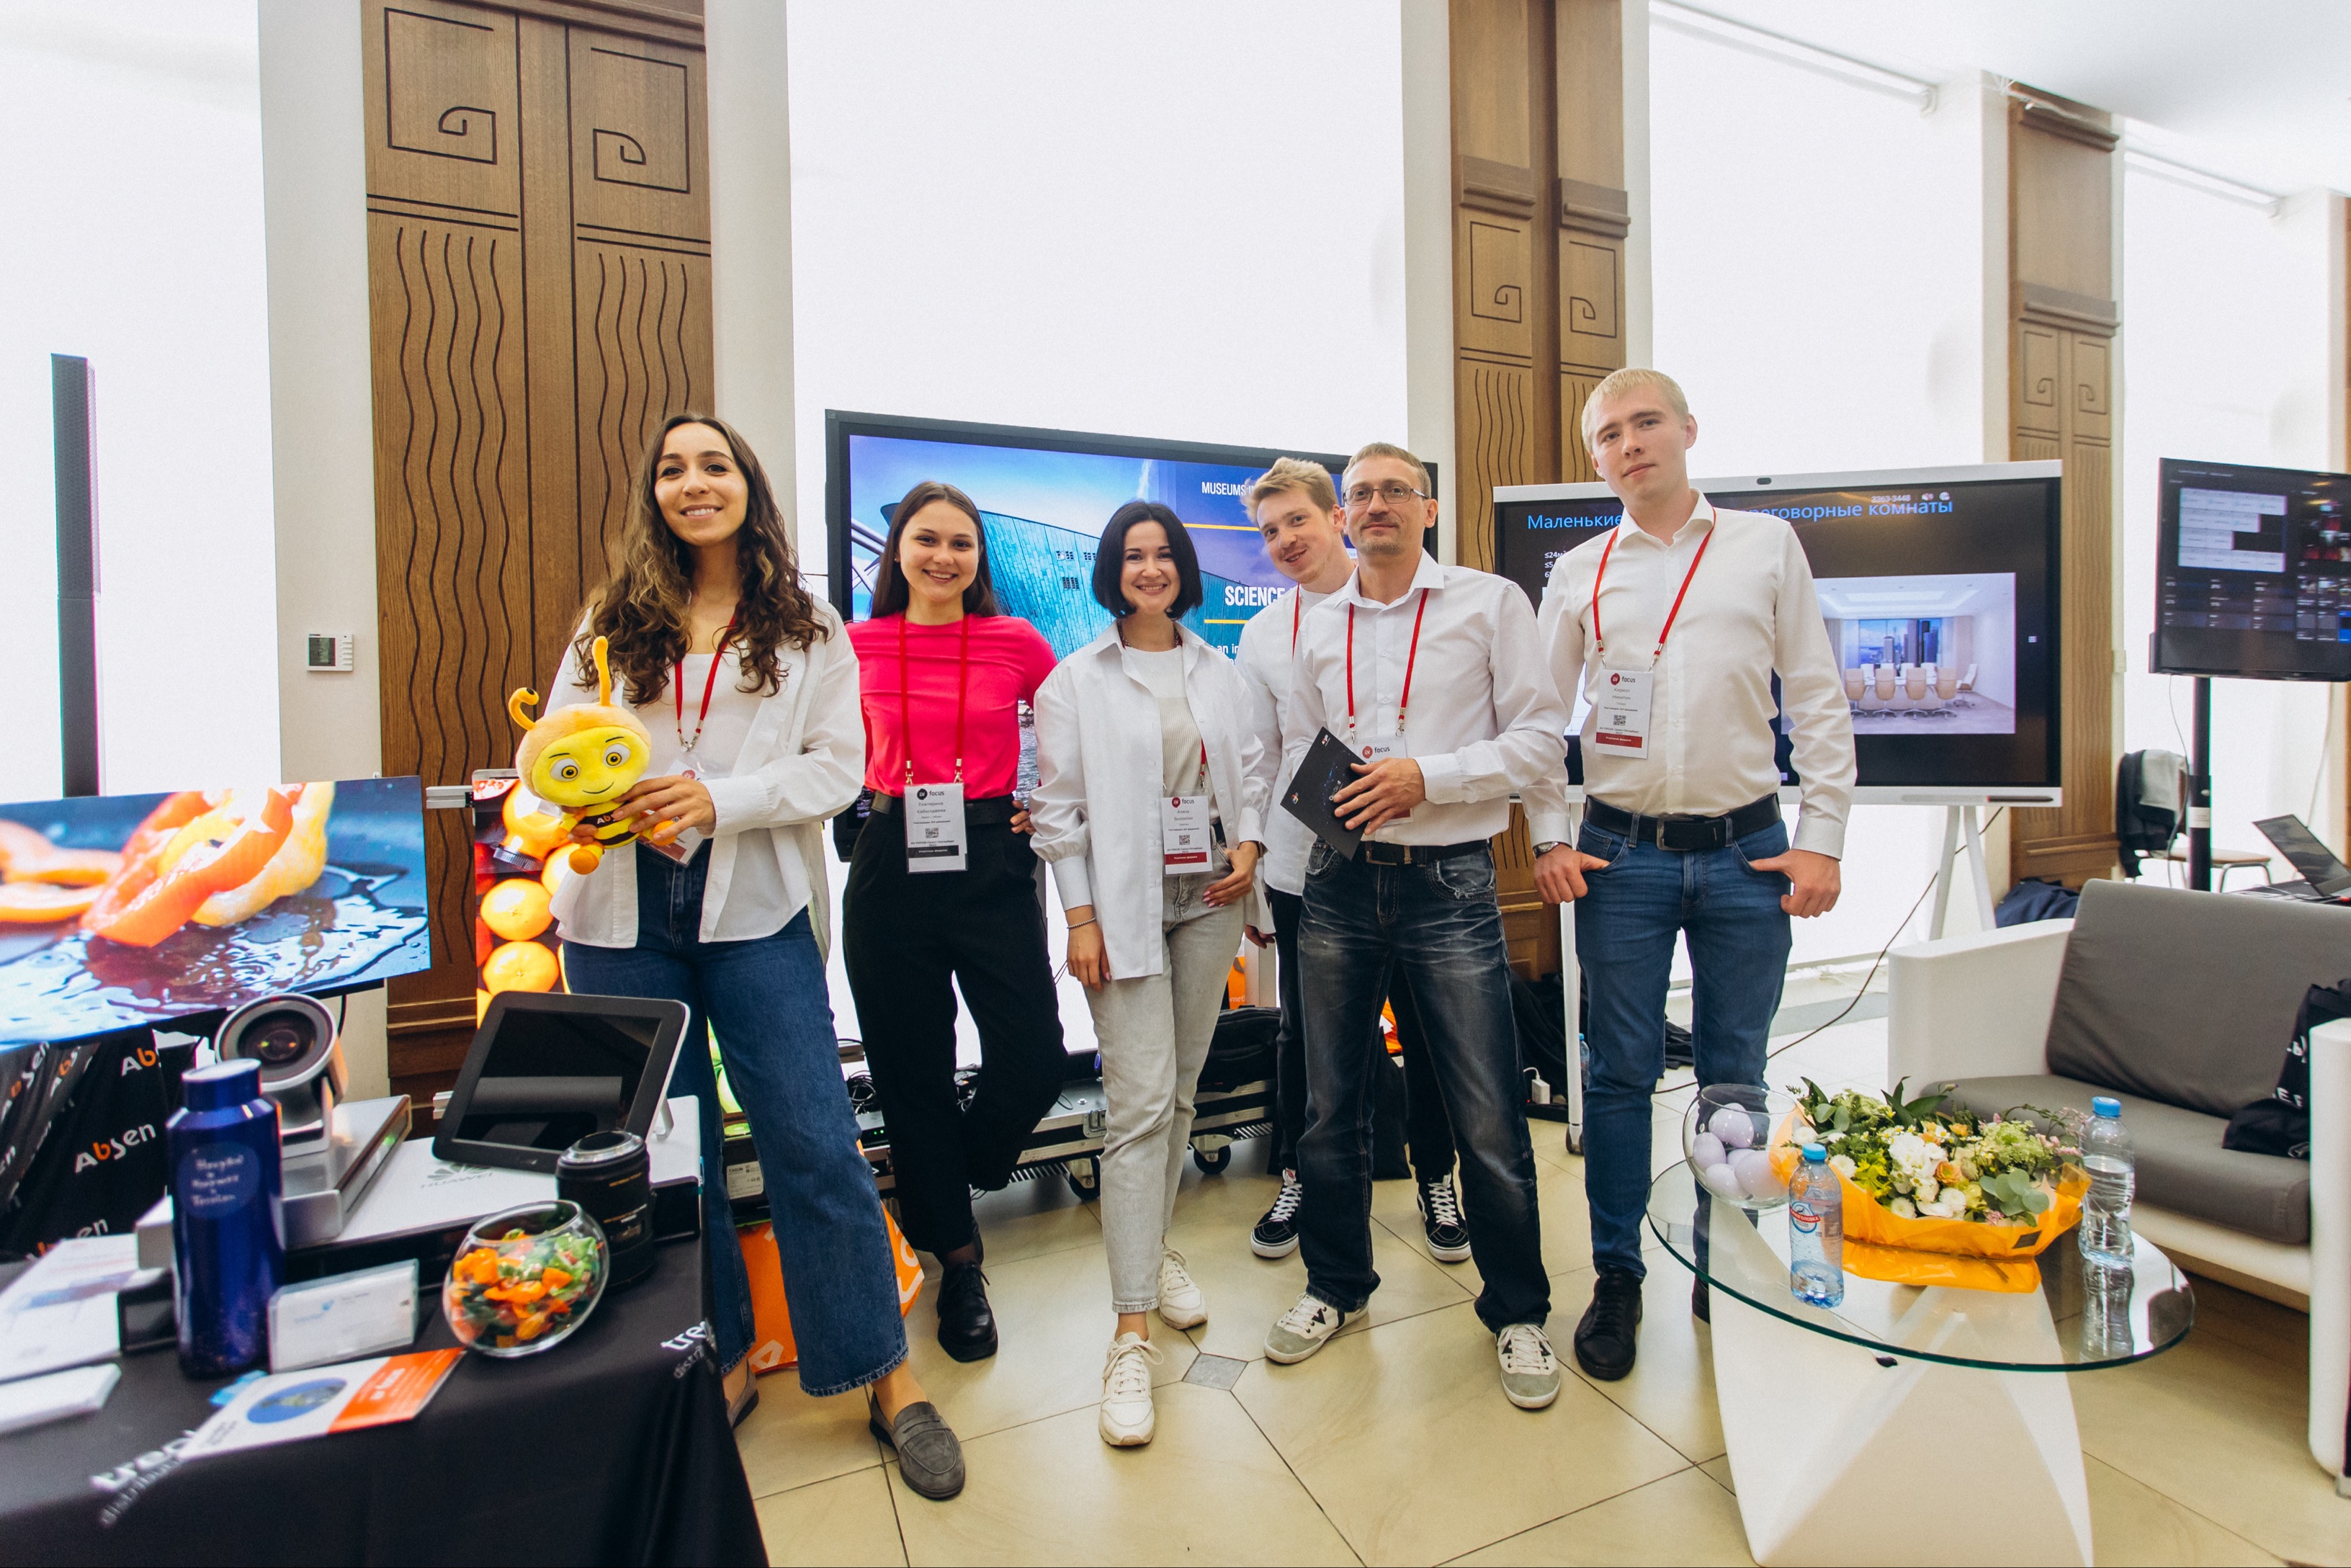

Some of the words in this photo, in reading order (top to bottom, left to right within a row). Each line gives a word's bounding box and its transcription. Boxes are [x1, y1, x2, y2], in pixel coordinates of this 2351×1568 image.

[1201, 481, 1247, 496] MUSEUMS
[1527, 514, 1622, 529] Маленькие
[1868, 501, 1953, 516] комнаты
[74, 1123, 156, 1174] Absen
